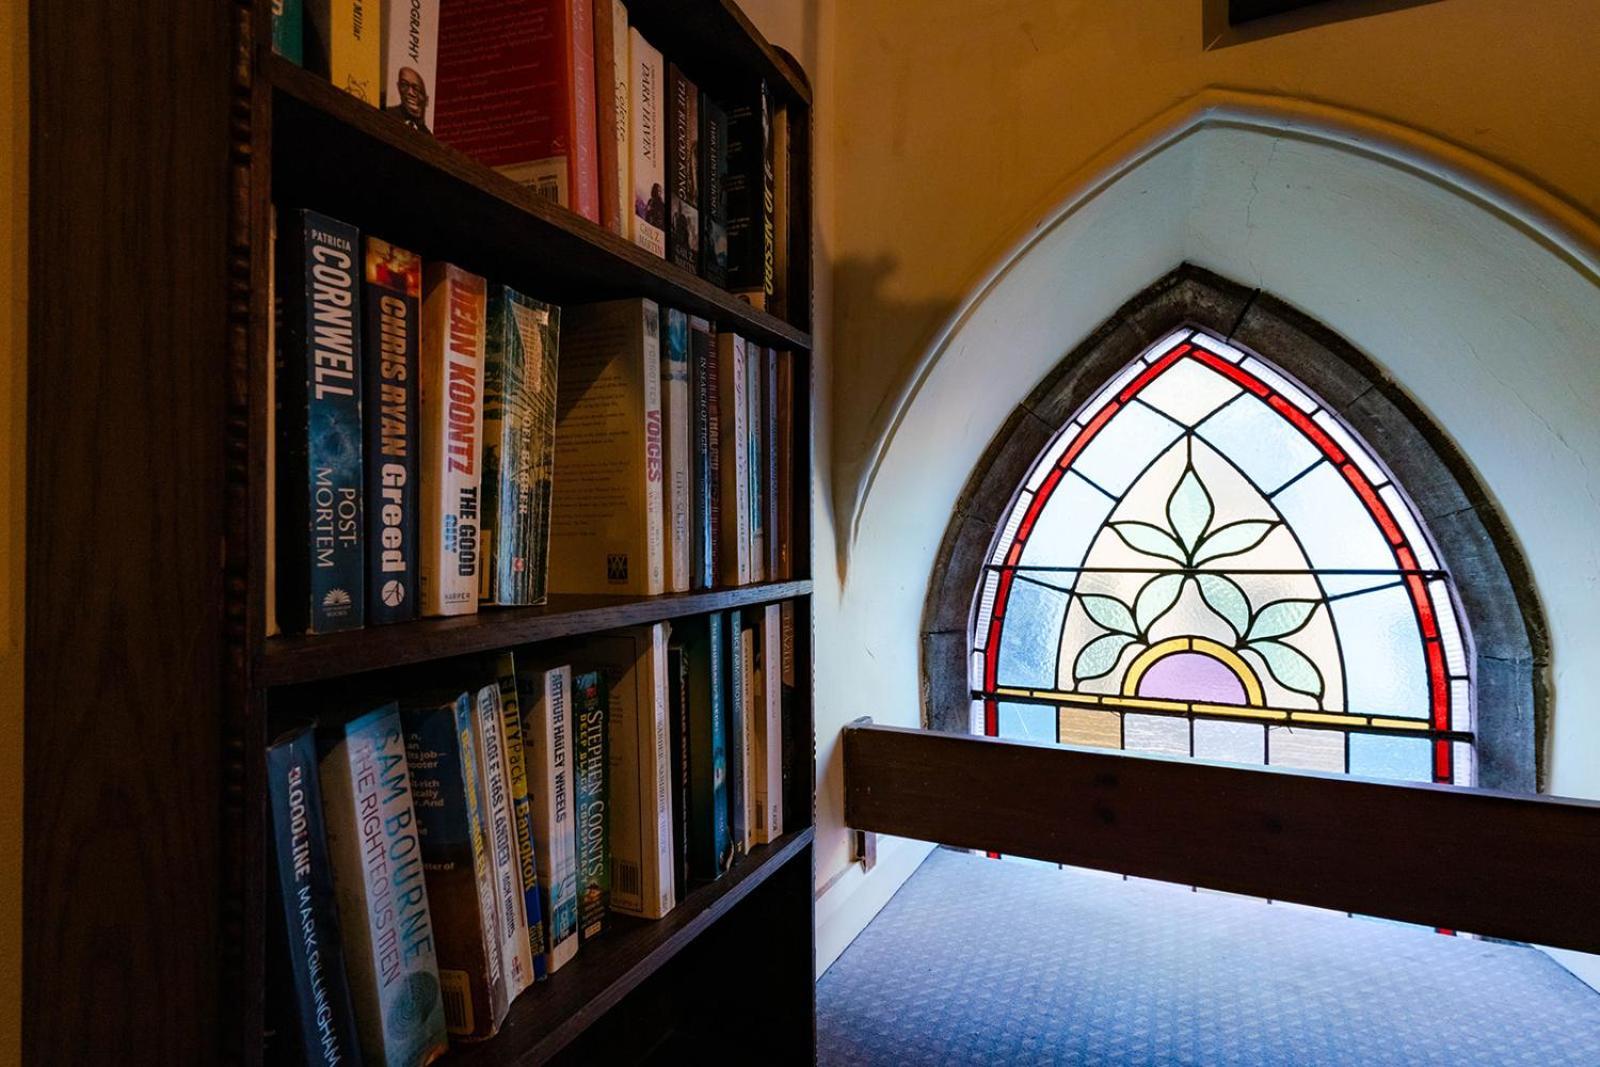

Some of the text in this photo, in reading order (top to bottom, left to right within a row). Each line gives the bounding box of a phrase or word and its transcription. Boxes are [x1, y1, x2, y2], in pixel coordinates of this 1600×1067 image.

[353, 2, 361, 40] Millar
[642, 63, 650, 160] DARK HAVEN
[312, 246, 353, 400] CORNWELL
[448, 281, 477, 476] DEAN KOONTZ
[379, 295, 407, 572] CHRIS RYAN Greed
[518, 407, 532, 515] NOEL BARBER
[647, 410, 660, 483] VOICES
[315, 468, 335, 568] MORTEM
[338, 487, 357, 549] POST-
[458, 487, 478, 577] THE GOOD
[375, 728, 408, 804] SAM
[550, 674, 567, 824] ARTHUR HAILEY WHEELS
[579, 713, 587, 748] DEEP
[586, 710, 604, 795] STEPHEN
[482, 696, 509, 866] THE EAGLE HAS LANDED
[355, 744, 401, 988] THE RIGHTEOUS MEN
[384, 807, 433, 967] BOURNE
[514, 802, 537, 891] Bangkok
[579, 803, 590, 885] CONSPIRACY
[587, 801, 605, 878] COONTS'
[288, 767, 342, 1067] BLOODLINE MARK BILLINGHAM
